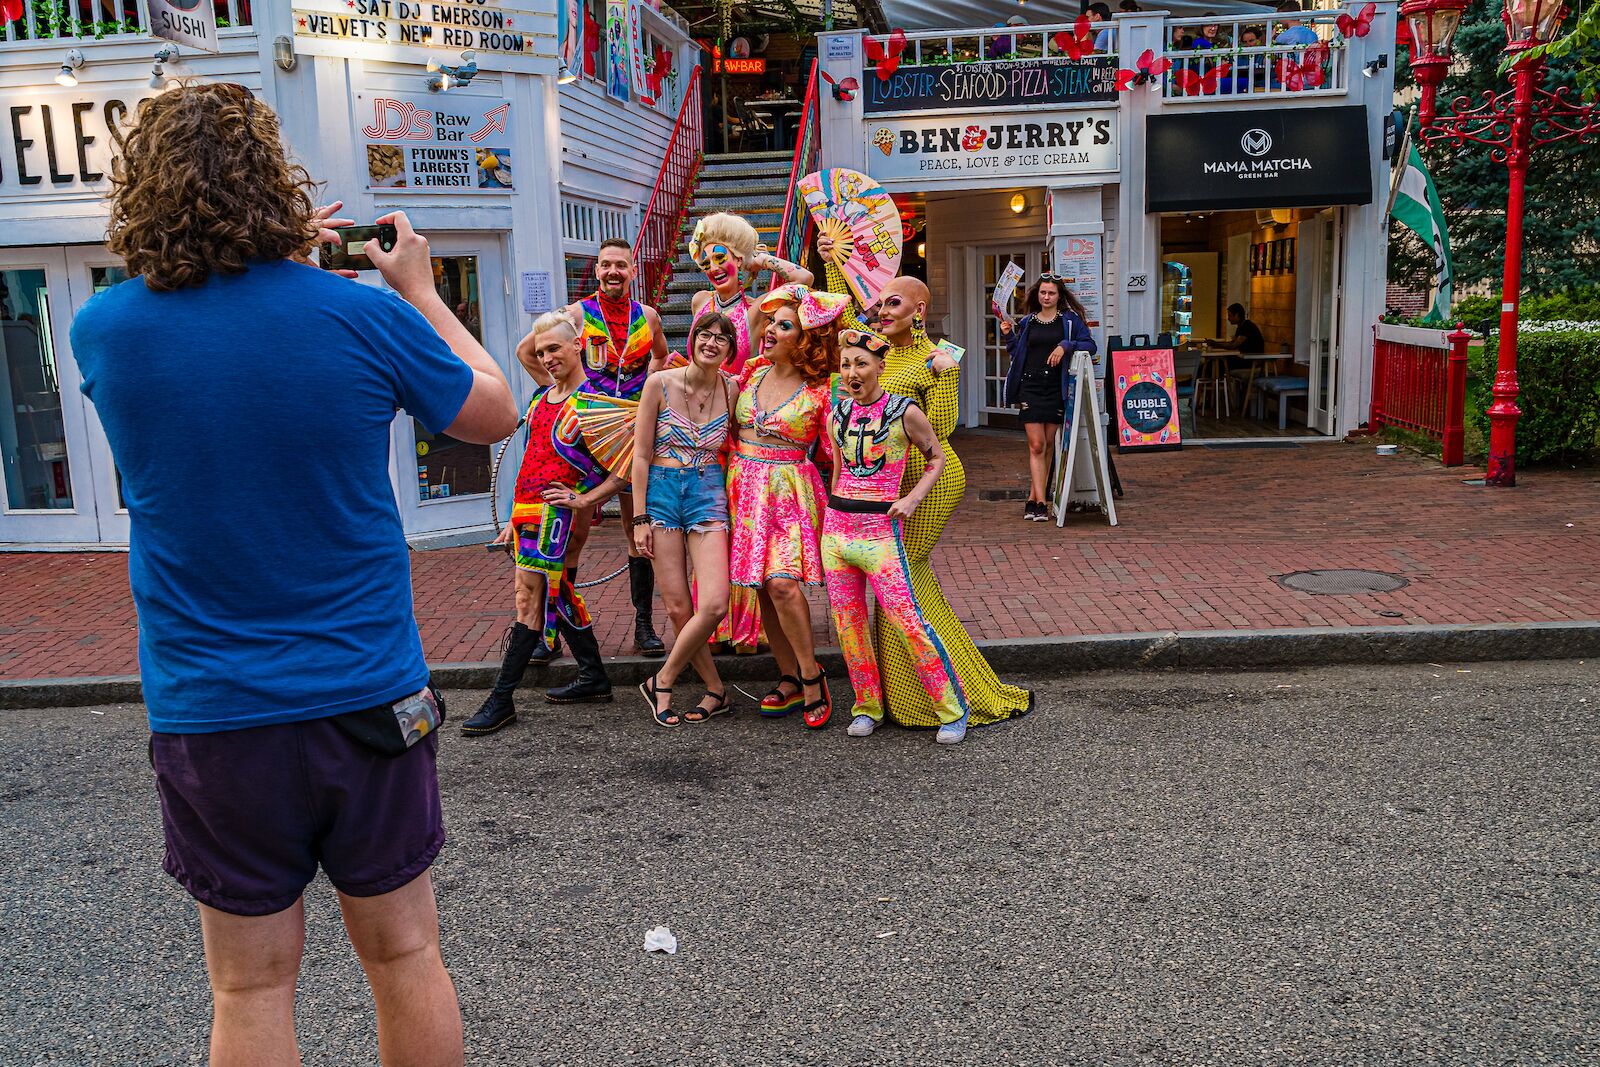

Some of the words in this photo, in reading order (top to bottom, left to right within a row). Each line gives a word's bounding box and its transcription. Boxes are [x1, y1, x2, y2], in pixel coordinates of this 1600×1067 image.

[357, 0, 391, 17] SAT
[400, 2, 421, 20] DJ
[432, 4, 503, 29] EMERSON
[161, 10, 206, 39] SUSHI
[308, 15, 387, 39] VELVET'S
[400, 24, 433, 43] NEW
[443, 28, 473, 47] RED
[480, 32, 524, 51] ROOM
[872, 73, 935, 104] LOBSTER
[939, 68, 1007, 101] SEAFOOD
[1010, 68, 1049, 98] PIZZA
[1053, 67, 1091, 98] STEAK
[435, 111, 471, 126] Raw
[436, 127, 465, 141] Bar
[899, 127, 961, 154] BEN
[986, 118, 1111, 150] JERRY'S
[412, 148, 469, 161] PTOWN'S
[920, 158, 962, 171] PEACE,
[967, 156, 999, 169] LOVE
[1004, 155, 1016, 167] &
[1018, 154, 1039, 166] ICE
[1043, 152, 1090, 165] CREAM
[413, 162, 470, 174] LARGEST
[1203, 161, 1248, 173] MAMA
[1251, 158, 1312, 171] MATCHA
[414, 176, 424, 186] &
[426, 175, 471, 187] FINEST!
[868, 238, 883, 255] IS
[872, 223, 900, 259] LOVE
[853, 235, 880, 271] LOVE
[1127, 275, 1147, 287] 258
[1126, 398, 1167, 410] BUBBLE
[1137, 410, 1158, 420] TEA
